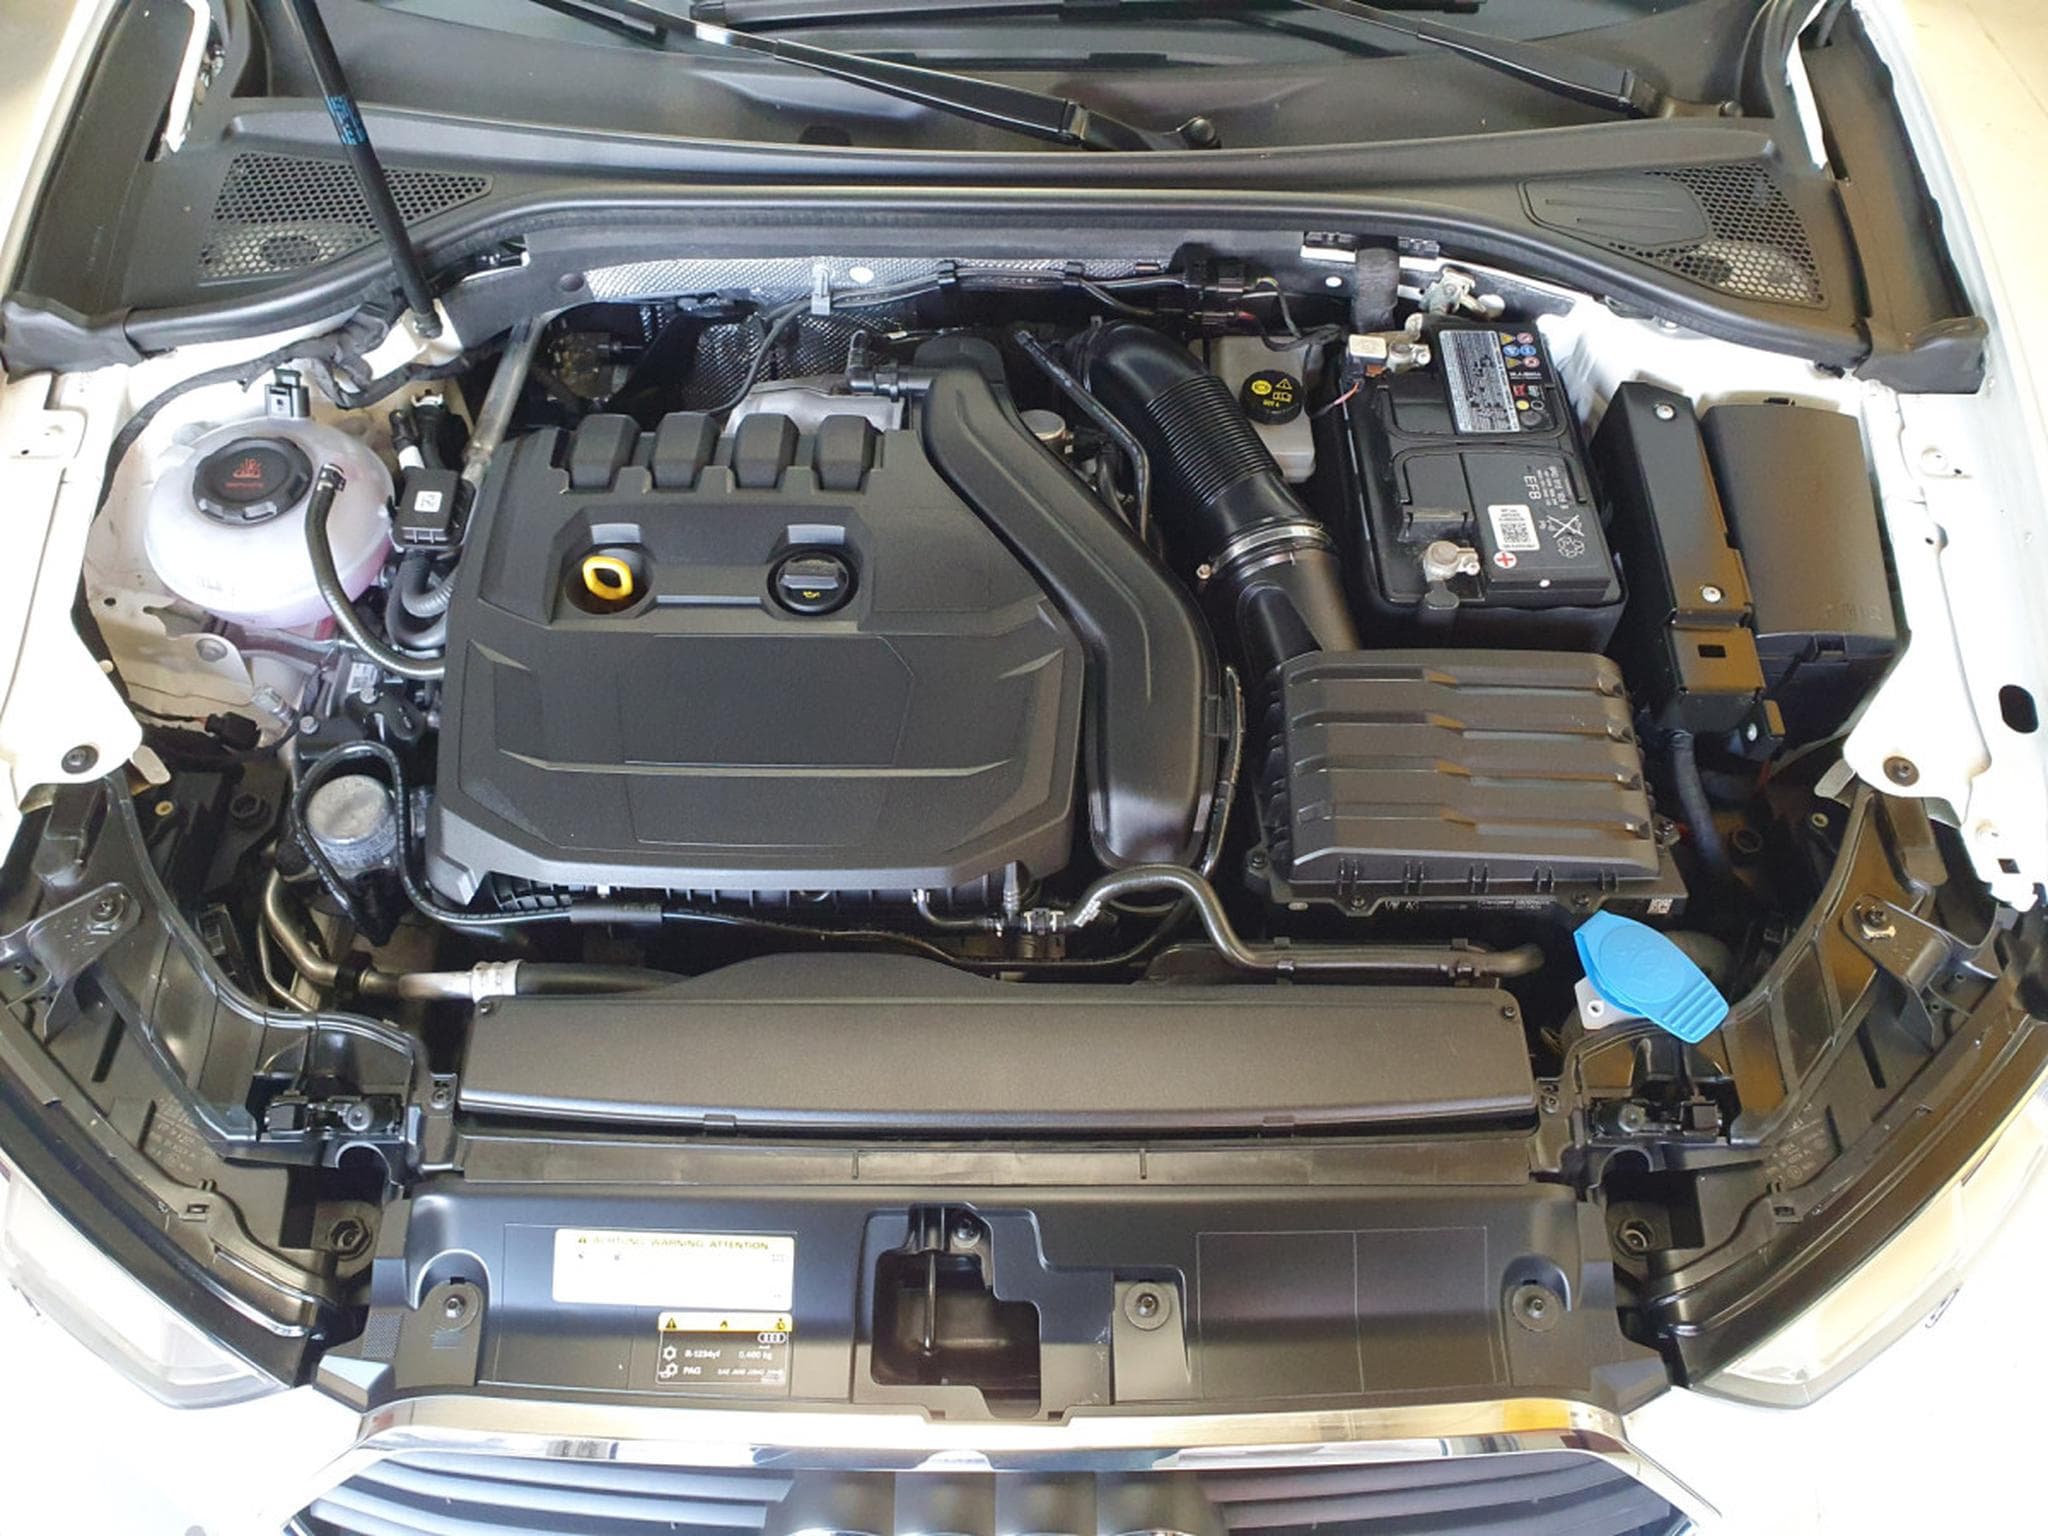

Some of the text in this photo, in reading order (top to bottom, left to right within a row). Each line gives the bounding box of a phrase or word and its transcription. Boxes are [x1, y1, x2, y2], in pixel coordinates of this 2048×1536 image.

[1523, 475, 1542, 500] EFB
[650, 1238, 705, 1248] WARNING
[708, 1239, 769, 1251] ATTENTION
[682, 1366, 702, 1375] PAG
